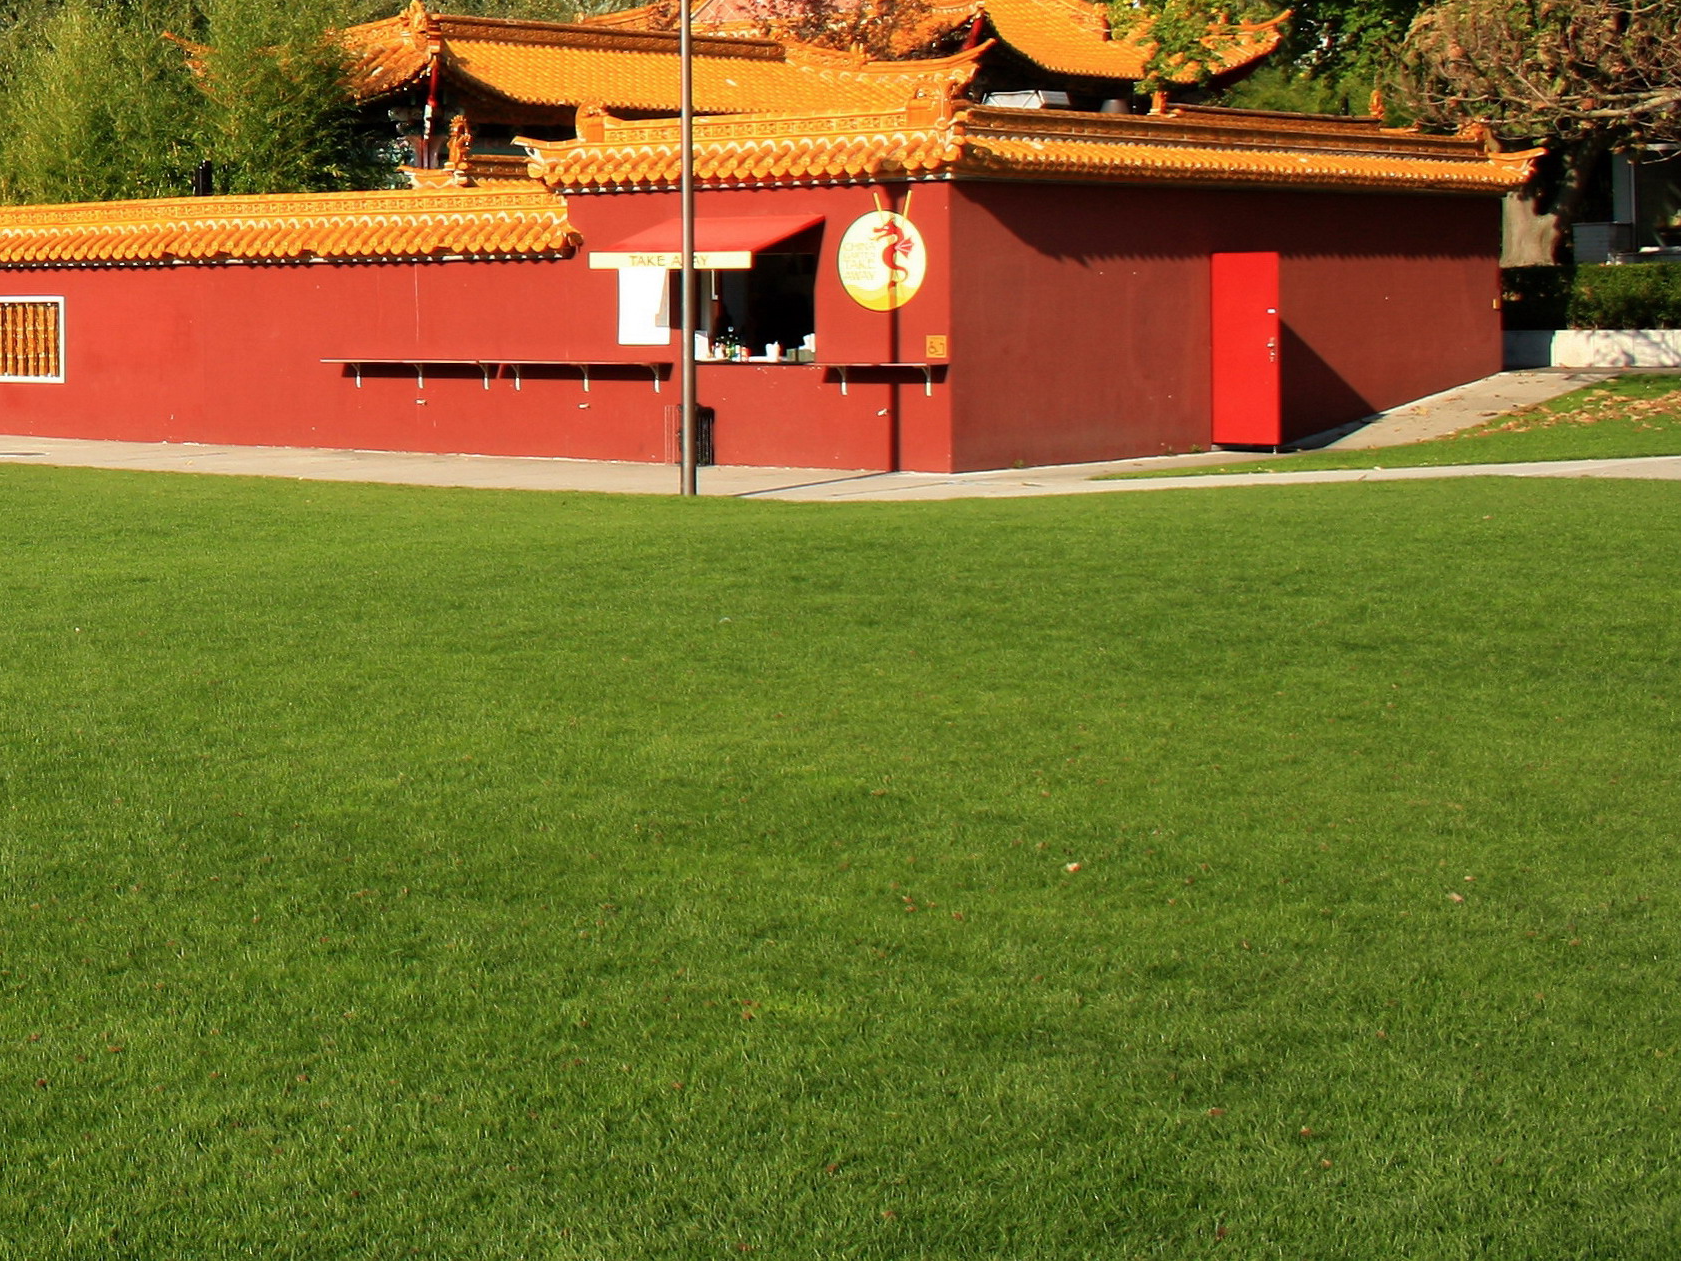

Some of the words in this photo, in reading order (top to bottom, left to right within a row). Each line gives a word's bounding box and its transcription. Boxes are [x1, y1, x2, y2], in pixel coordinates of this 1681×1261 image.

[629, 255, 666, 267] TAKE
[670, 255, 709, 267] AAY
[843, 260, 876, 270] TAKE
